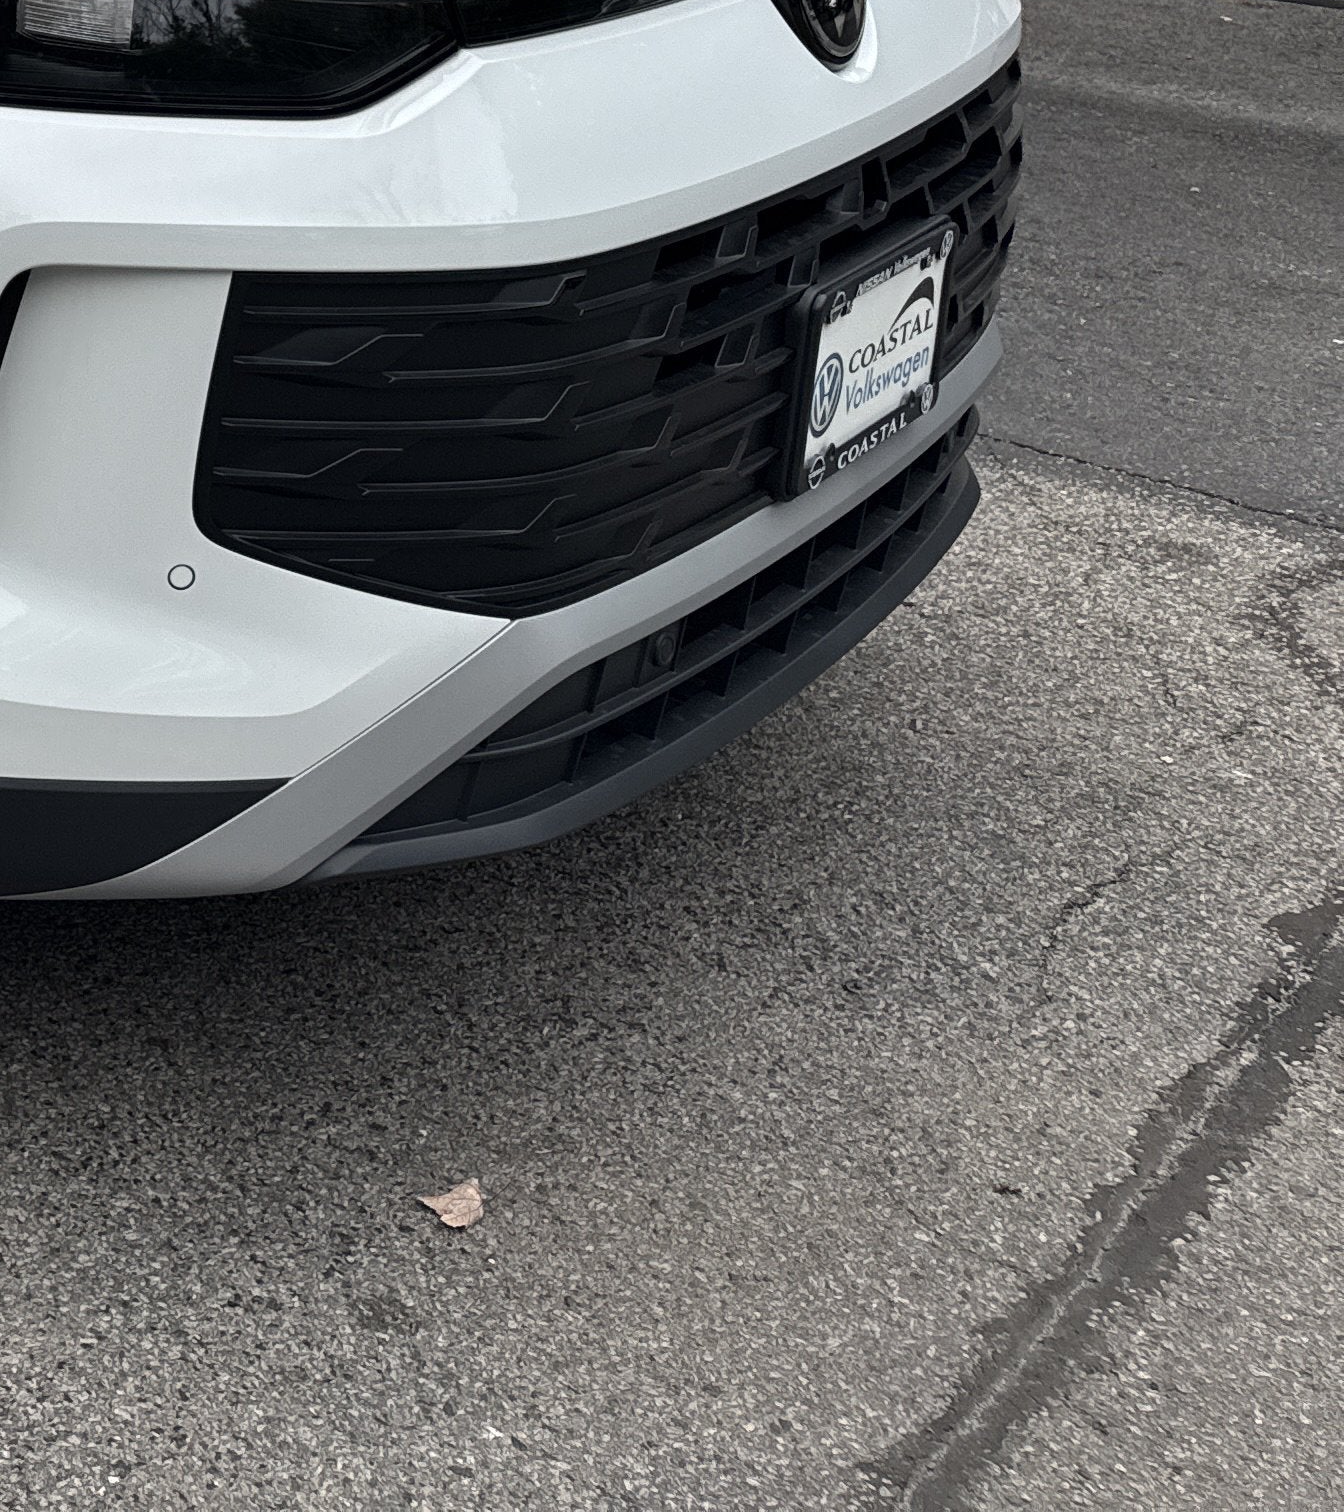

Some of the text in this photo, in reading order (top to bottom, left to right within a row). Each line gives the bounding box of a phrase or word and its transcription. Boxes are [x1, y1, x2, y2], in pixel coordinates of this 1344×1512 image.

[848, 308, 934, 374] COASTAL
[845, 346, 930, 416] Volkswagen
[837, 411, 908, 470] COASTAL
